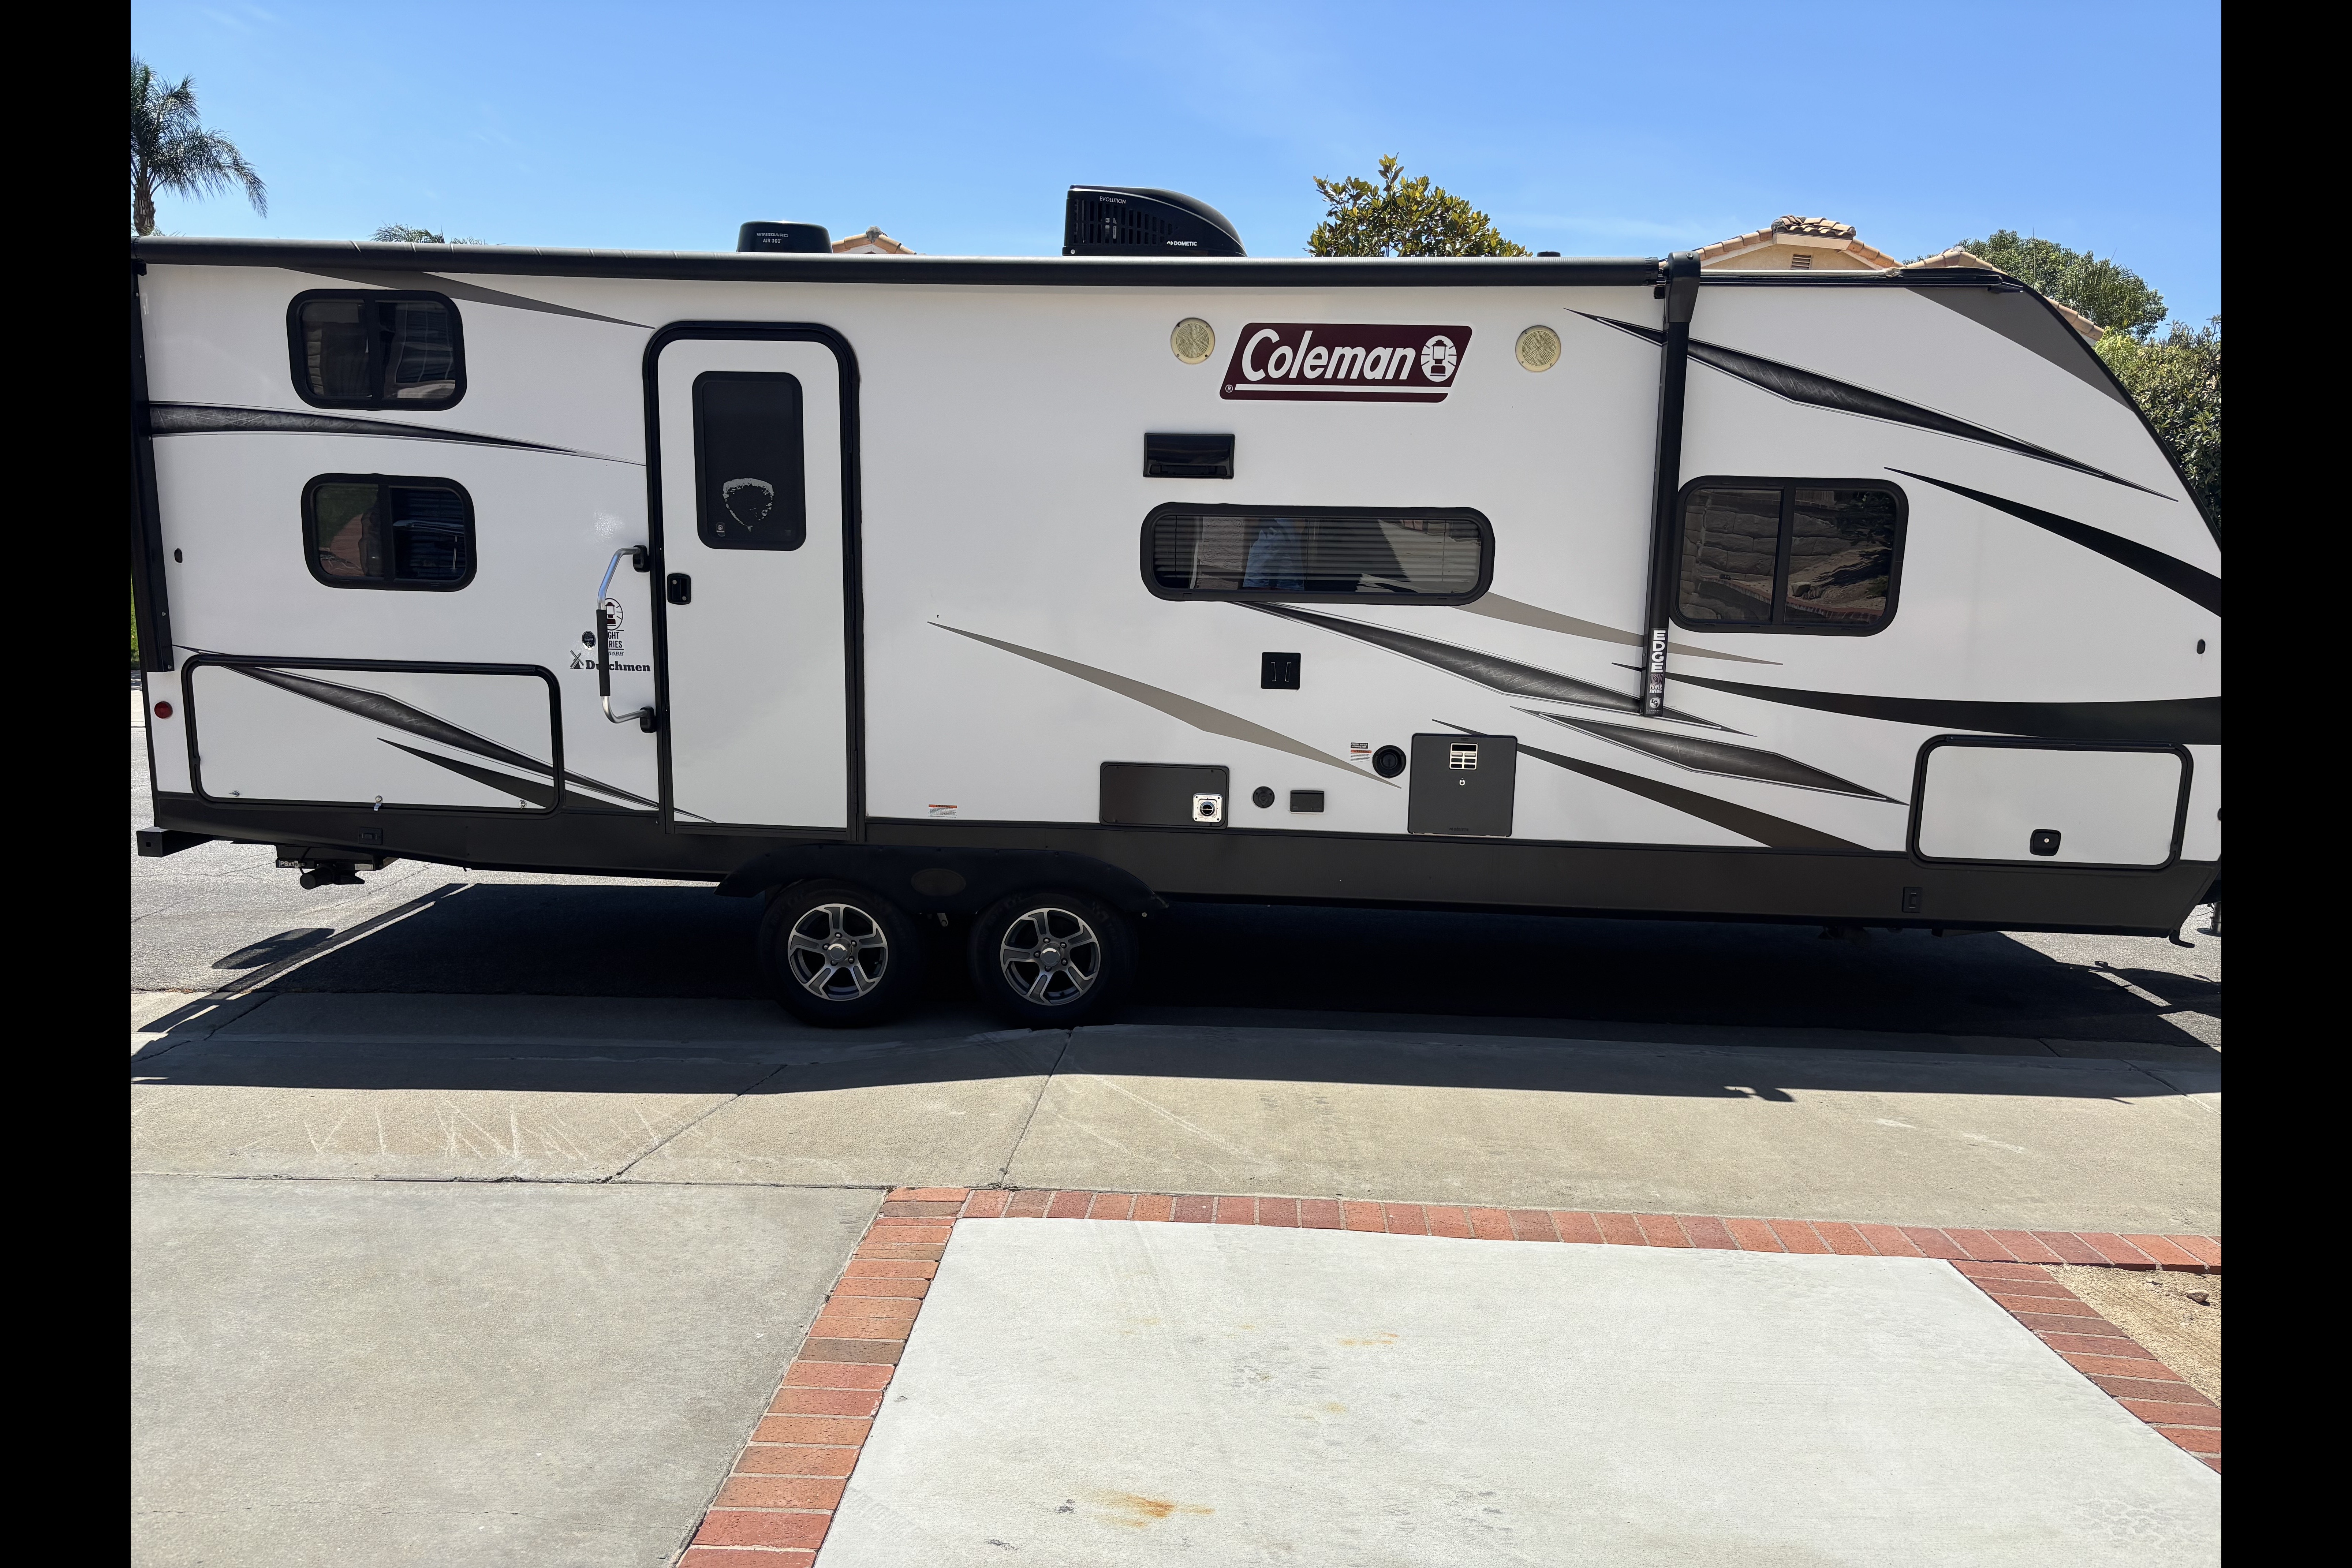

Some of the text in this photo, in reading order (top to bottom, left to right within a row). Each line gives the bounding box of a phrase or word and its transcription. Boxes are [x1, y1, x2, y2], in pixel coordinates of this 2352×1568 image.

[1100, 196, 1126, 204] EVOLUTION
[1242, 328, 1416, 381] Coleman
[608, 631, 619, 639] GHT
[609, 640, 623, 648] RIES
[1651, 630, 1666, 673] EDGE
[586, 660, 650, 672] Dchmen
[1650, 674, 1663, 684] 12V
